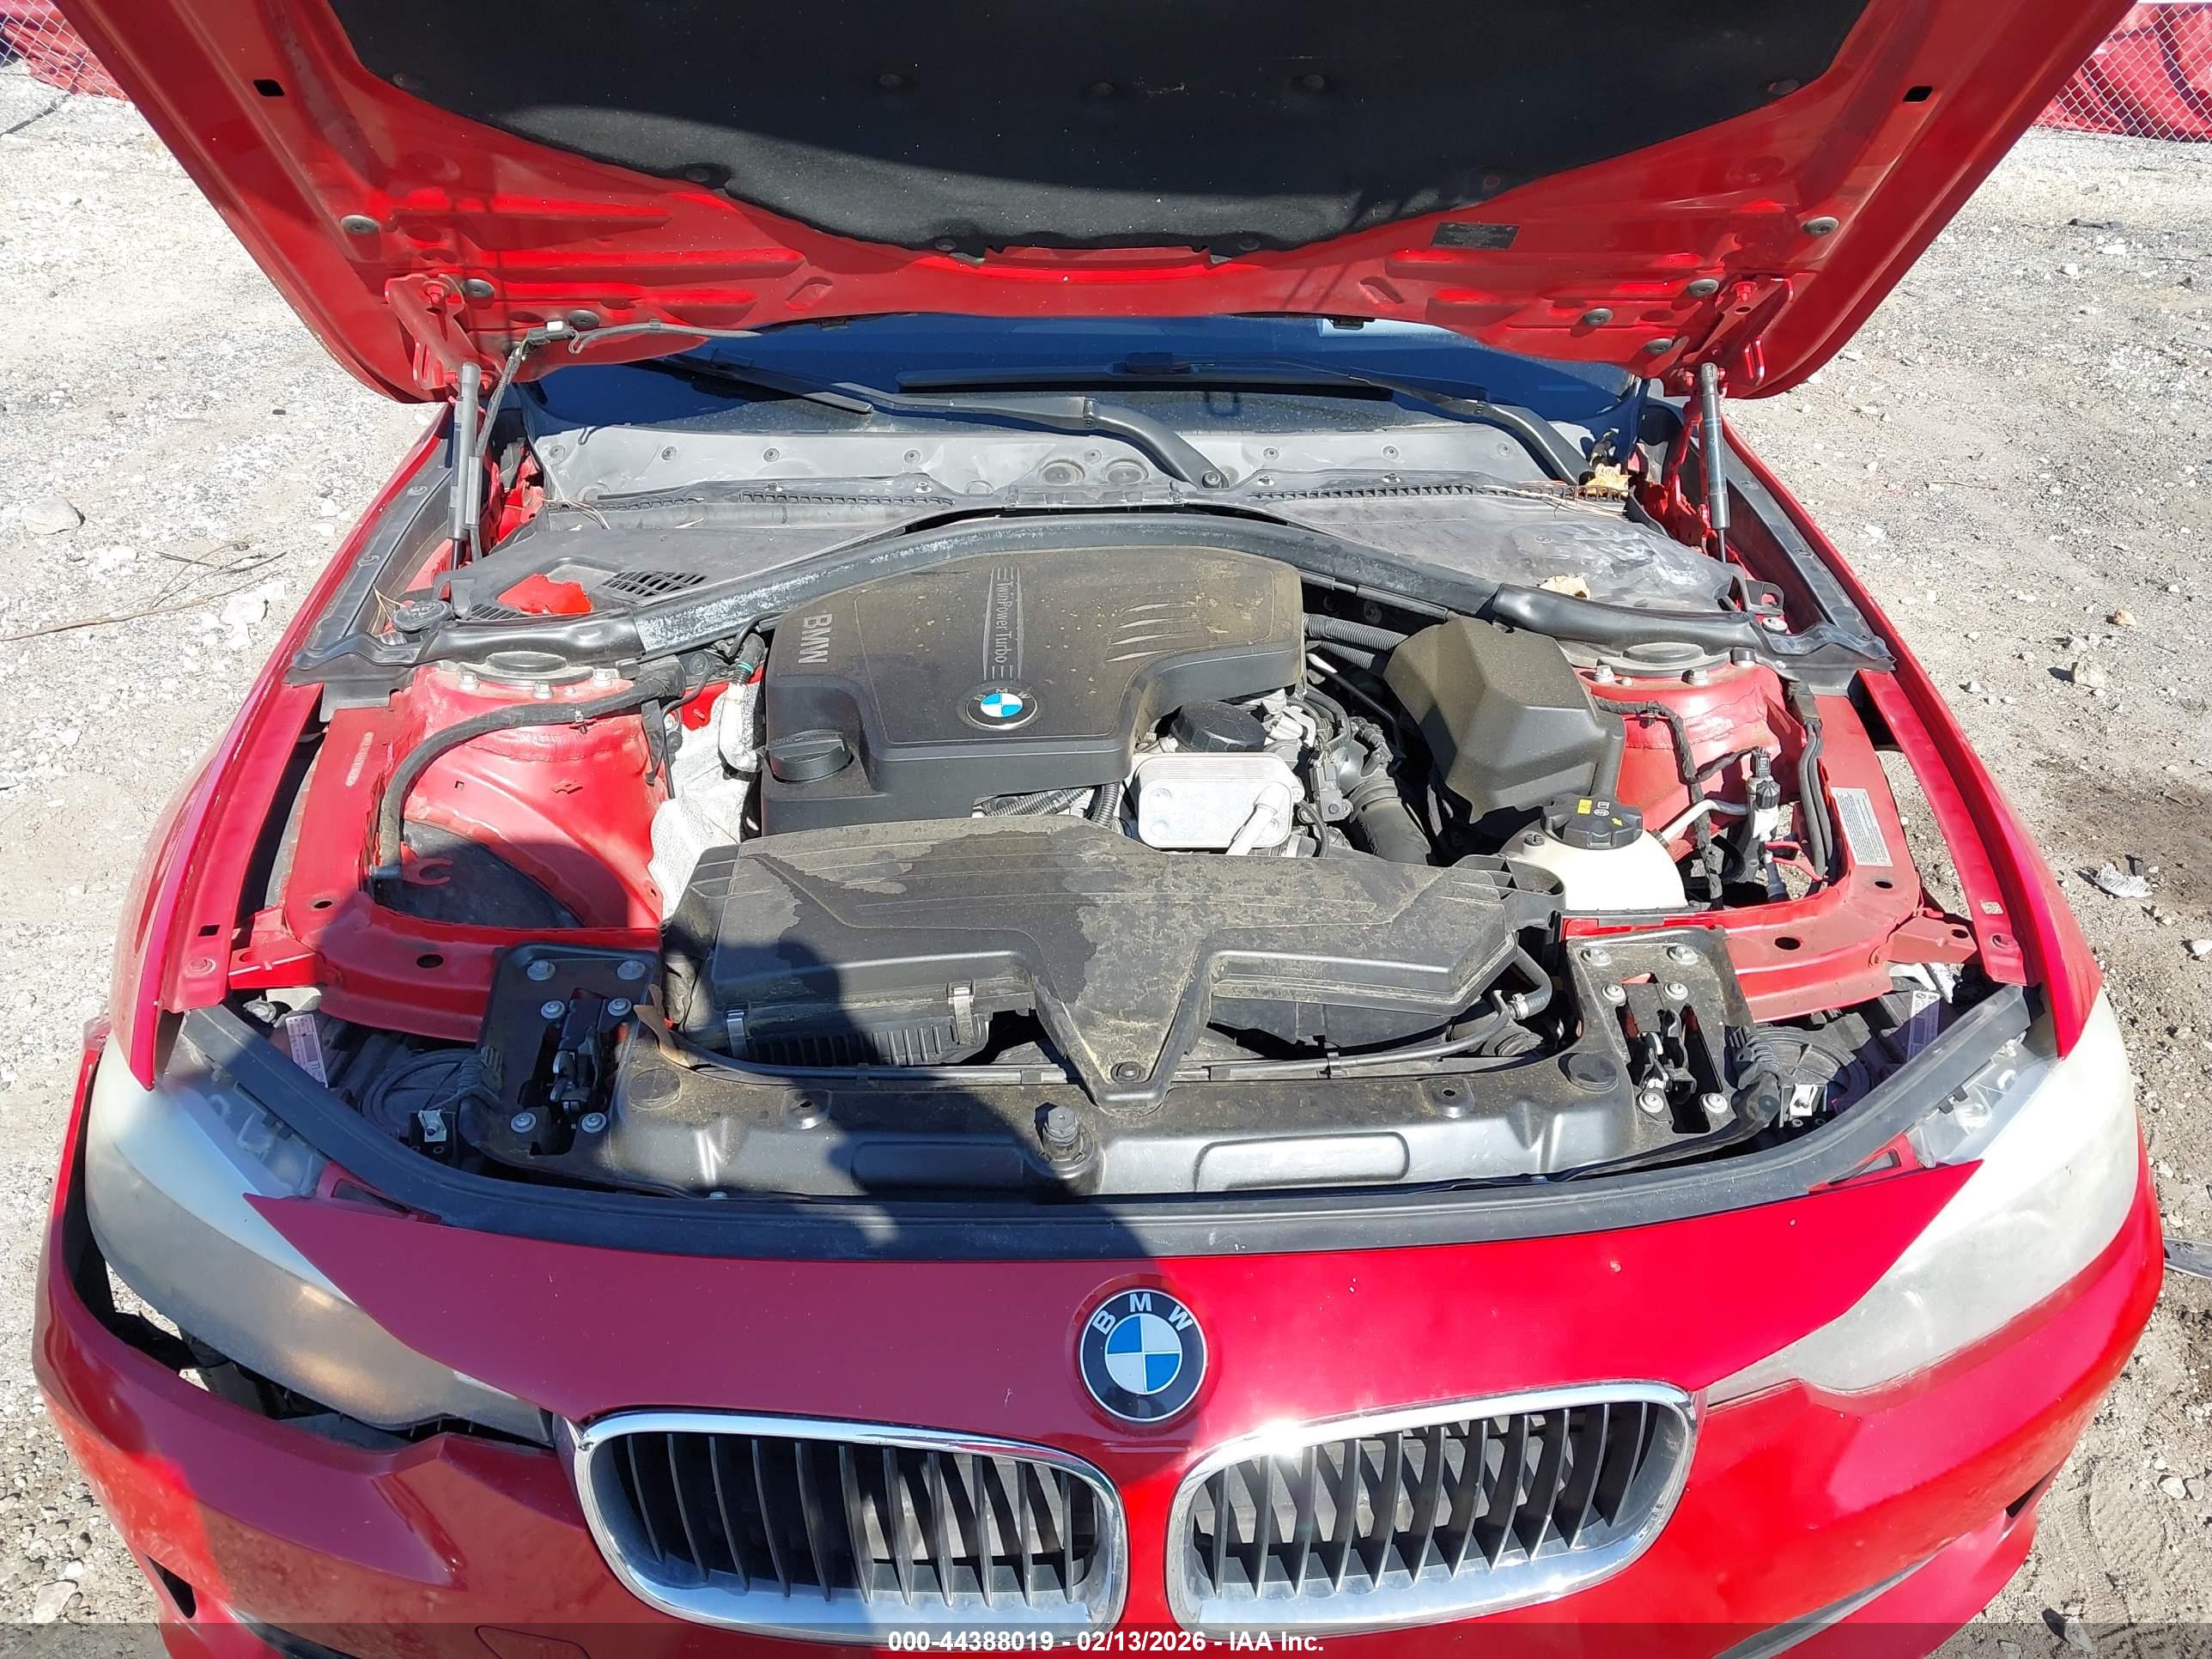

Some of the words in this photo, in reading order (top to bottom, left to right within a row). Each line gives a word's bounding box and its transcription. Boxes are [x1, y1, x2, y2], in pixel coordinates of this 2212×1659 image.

[798, 613, 833, 665] BMW
[973, 688, 1031, 702] BMW
[1091, 1293, 1194, 1335] BMW
